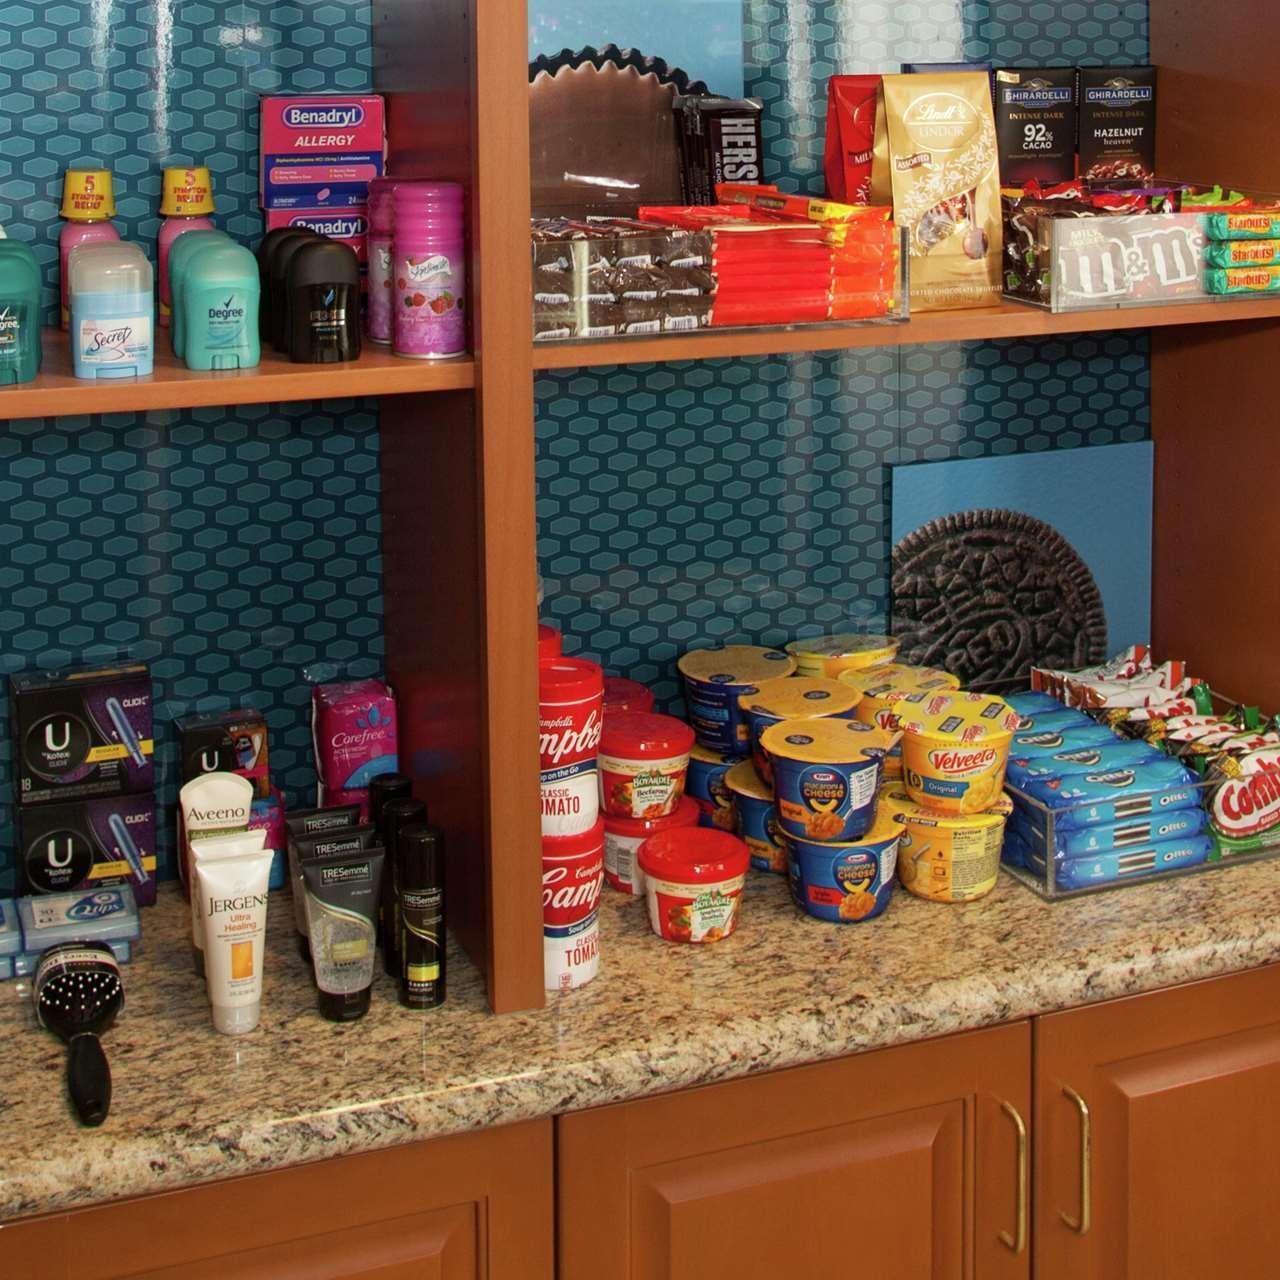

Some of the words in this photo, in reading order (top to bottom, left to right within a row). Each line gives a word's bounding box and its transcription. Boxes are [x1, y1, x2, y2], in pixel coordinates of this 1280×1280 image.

[1005, 90, 1069, 101] GHIRARDELLI
[1088, 90, 1150, 100] GHIRARDELLI
[290, 108, 357, 126] Benadryl
[1009, 112, 1042, 120] INTENSE
[1043, 111, 1065, 119] DARK
[1093, 127, 1144, 138] HAZELNUT
[294, 134, 356, 147] ALLERGY
[1022, 141, 1053, 151] CACAO
[84, 175, 95, 191] 5
[184, 169, 196, 185] 5
[208, 307, 244, 321] Degree
[92, 326, 133, 352] Secret
[45, 721, 71, 752] U
[331, 729, 387, 749] Corefree
[201, 750, 219, 772] U
[933, 748, 996, 771] Velveeta
[557, 768, 569, 778] the
[569, 765, 579, 774] Go
[21, 778, 32, 791] 18
[928, 782, 959, 794] Original
[187, 806, 246, 824] Aveeno
[47, 837, 73, 868] U
[321, 864, 369, 879] TRESemmé
[208, 892, 269, 917] JERGENS
[230, 913, 252, 923] Ultra
[224, 921, 257, 933] Healing
